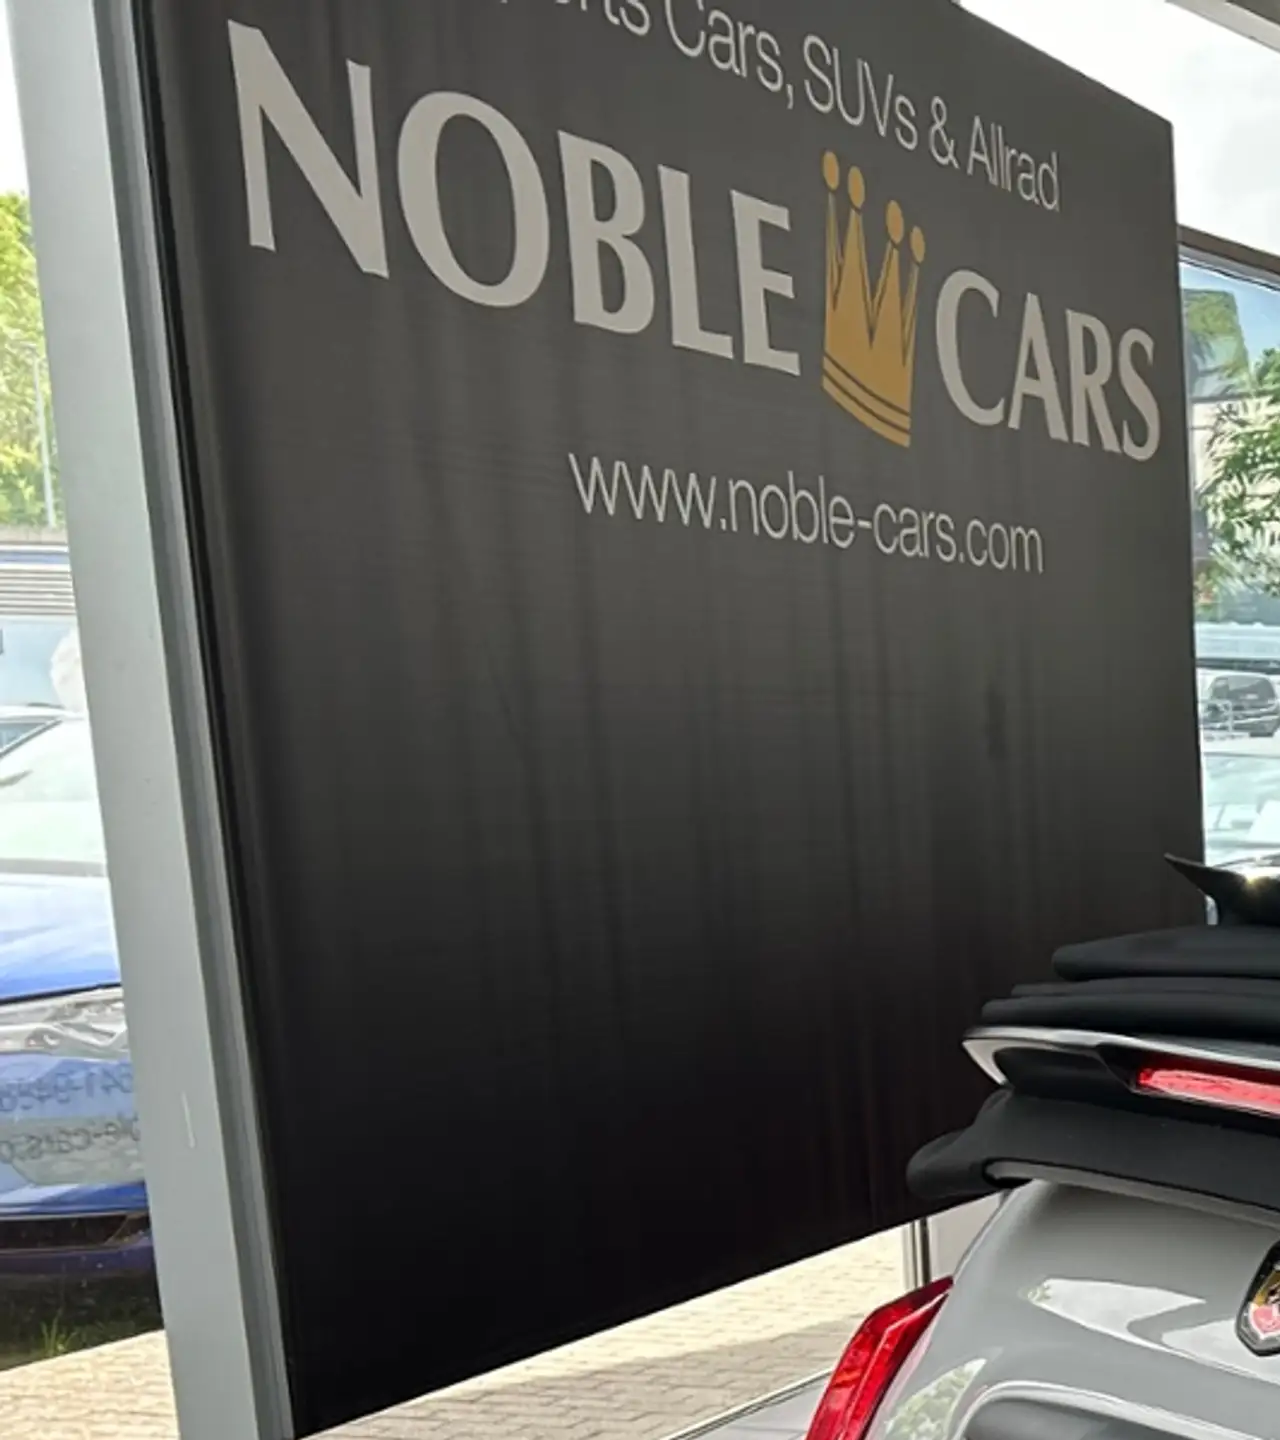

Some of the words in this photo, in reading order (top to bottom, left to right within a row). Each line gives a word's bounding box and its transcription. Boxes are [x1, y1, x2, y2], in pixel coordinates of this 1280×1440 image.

[803, 35, 918, 151] SUVs
[929, 96, 959, 170] &
[967, 115, 1059, 212] Allrad
[228, 19, 801, 376] NOBLE
[935, 269, 1161, 461] CARS
[568, 453, 1045, 574] www.noble-cars.com
